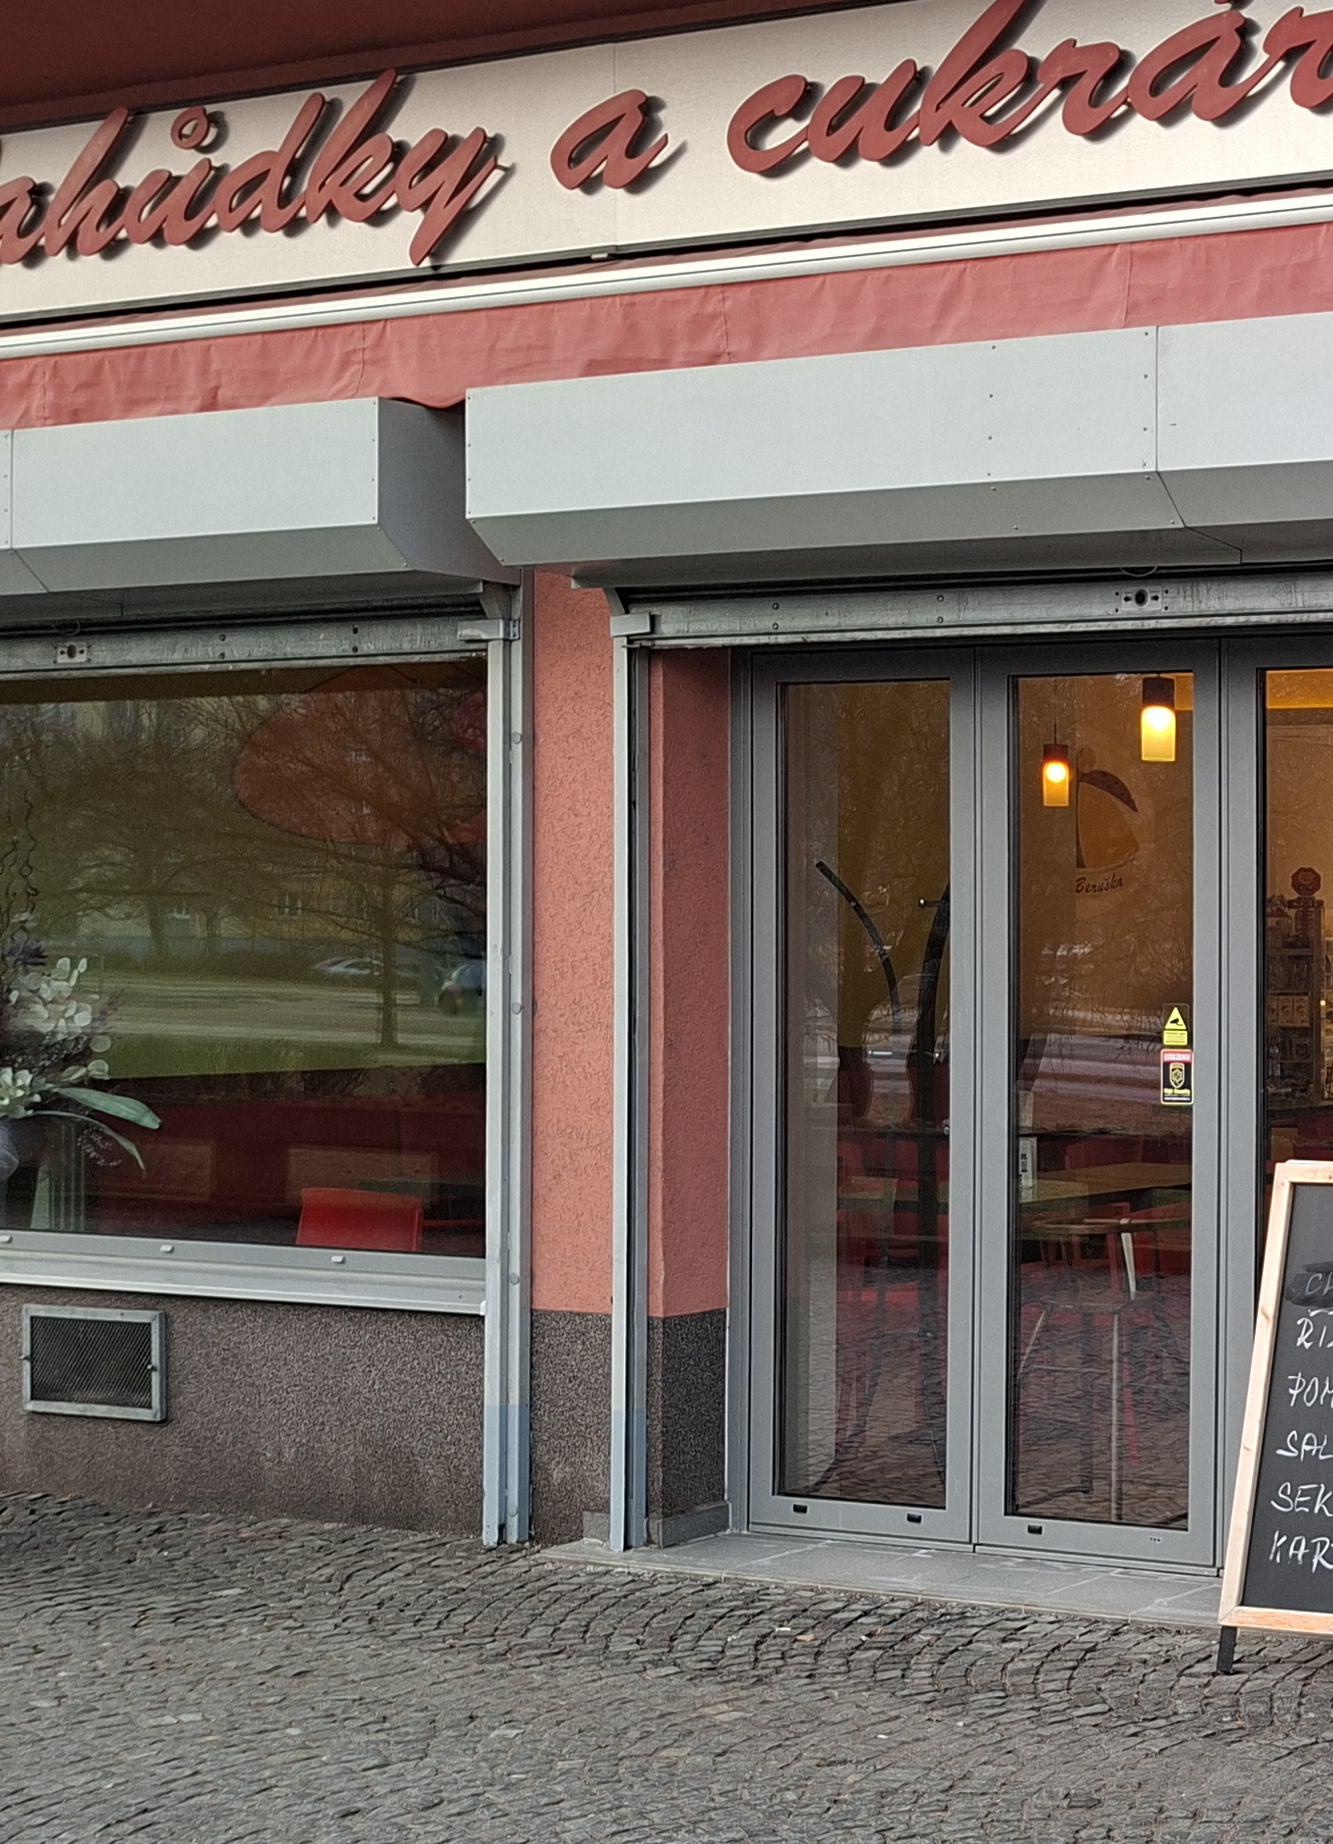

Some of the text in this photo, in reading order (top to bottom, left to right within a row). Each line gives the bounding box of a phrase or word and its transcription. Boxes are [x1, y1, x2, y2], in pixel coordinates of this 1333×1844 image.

[0, 68, 498, 267] ahůdky
[550, 89, 668, 190] a
[1075, 873, 1124, 894] Beruška
